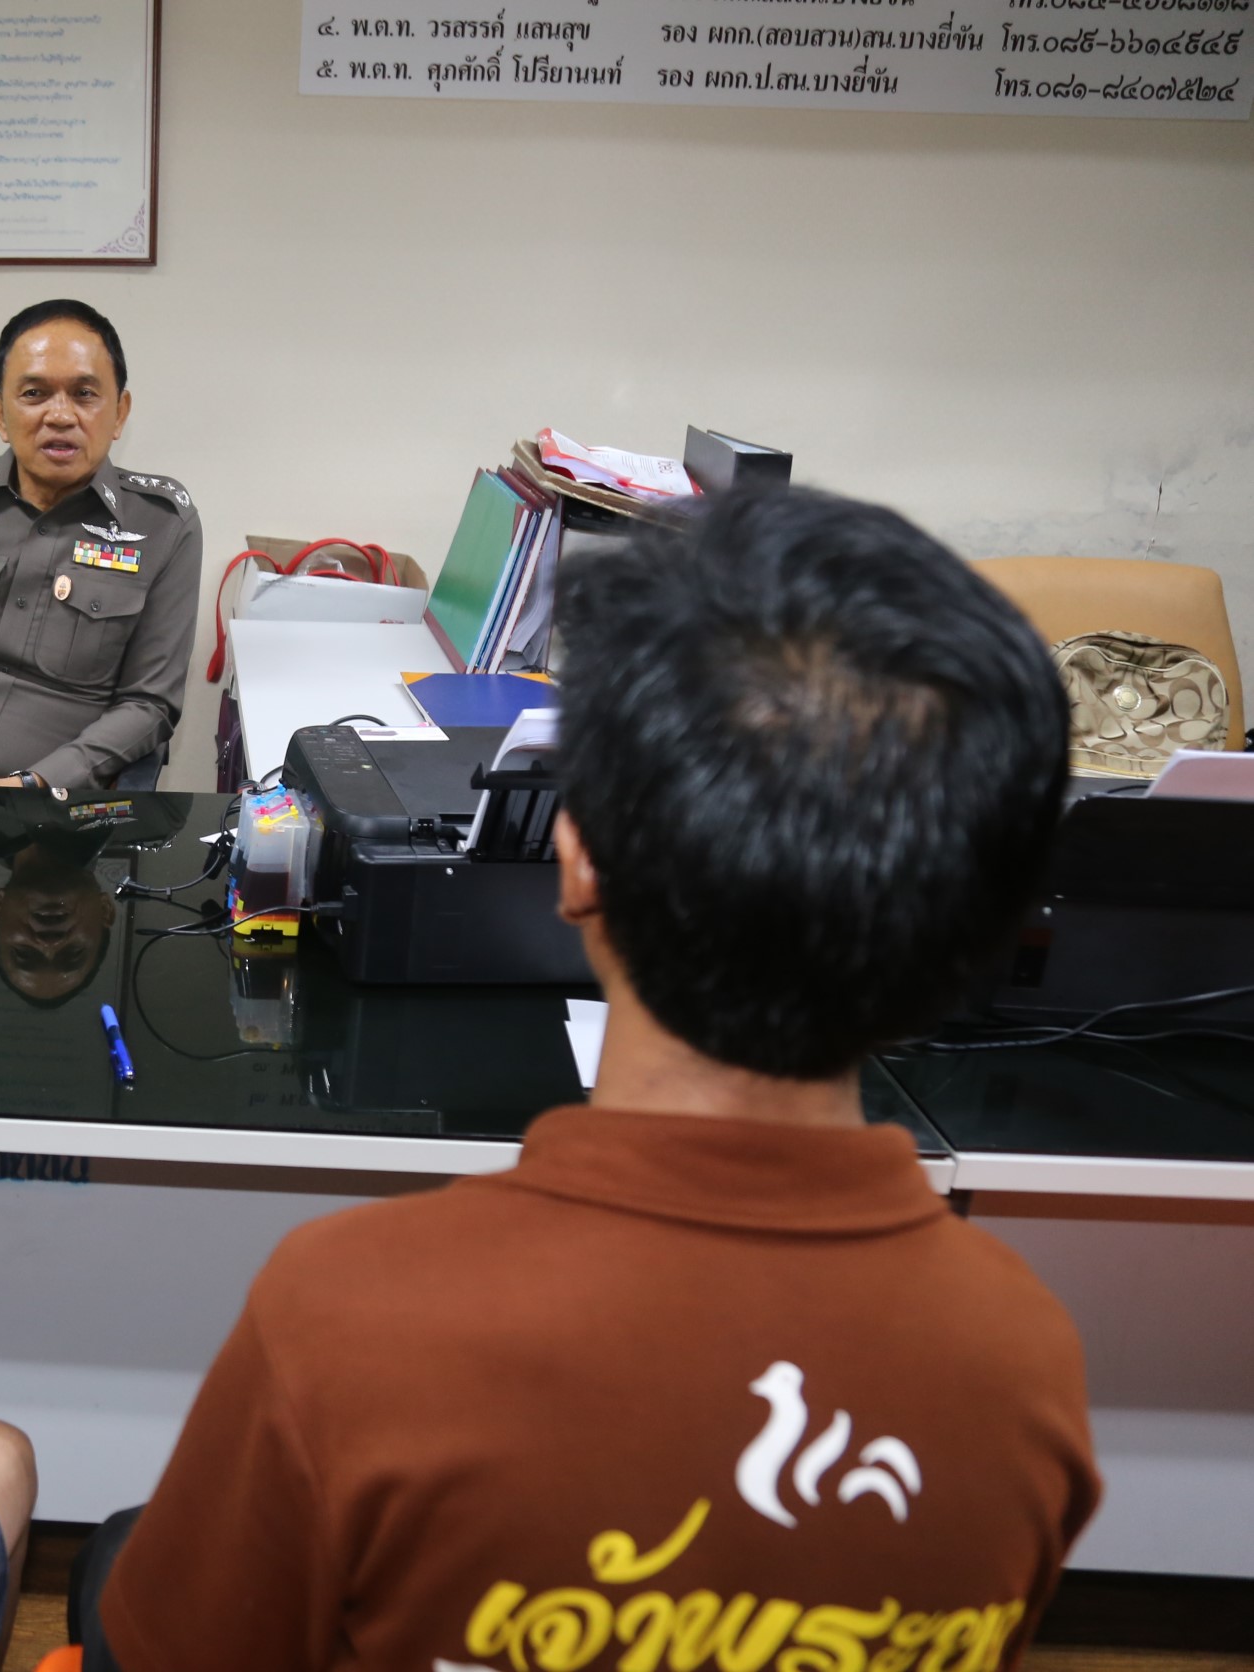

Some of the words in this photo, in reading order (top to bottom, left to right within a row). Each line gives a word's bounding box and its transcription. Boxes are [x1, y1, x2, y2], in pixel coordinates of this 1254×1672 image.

[317, 16, 340, 36] ๔.
[351, 17, 415, 37] พ.ต.ท.
[427, 8, 507, 39] วรสรรค์
[515, 20, 590, 51] แสนสุข
[661, 24, 697, 44] รอง
[316, 59, 338, 79] ๕.
[349, 60, 413, 80] พ.ต.ท.
[427, 46, 505, 92] ศุภศักดิ์
[512, 52, 625, 85] โปรียานนท์
[657, 68, 694, 88] รอง
[704, 55, 898, 94] ผกก.ป.สน.บางยี่ขัน
